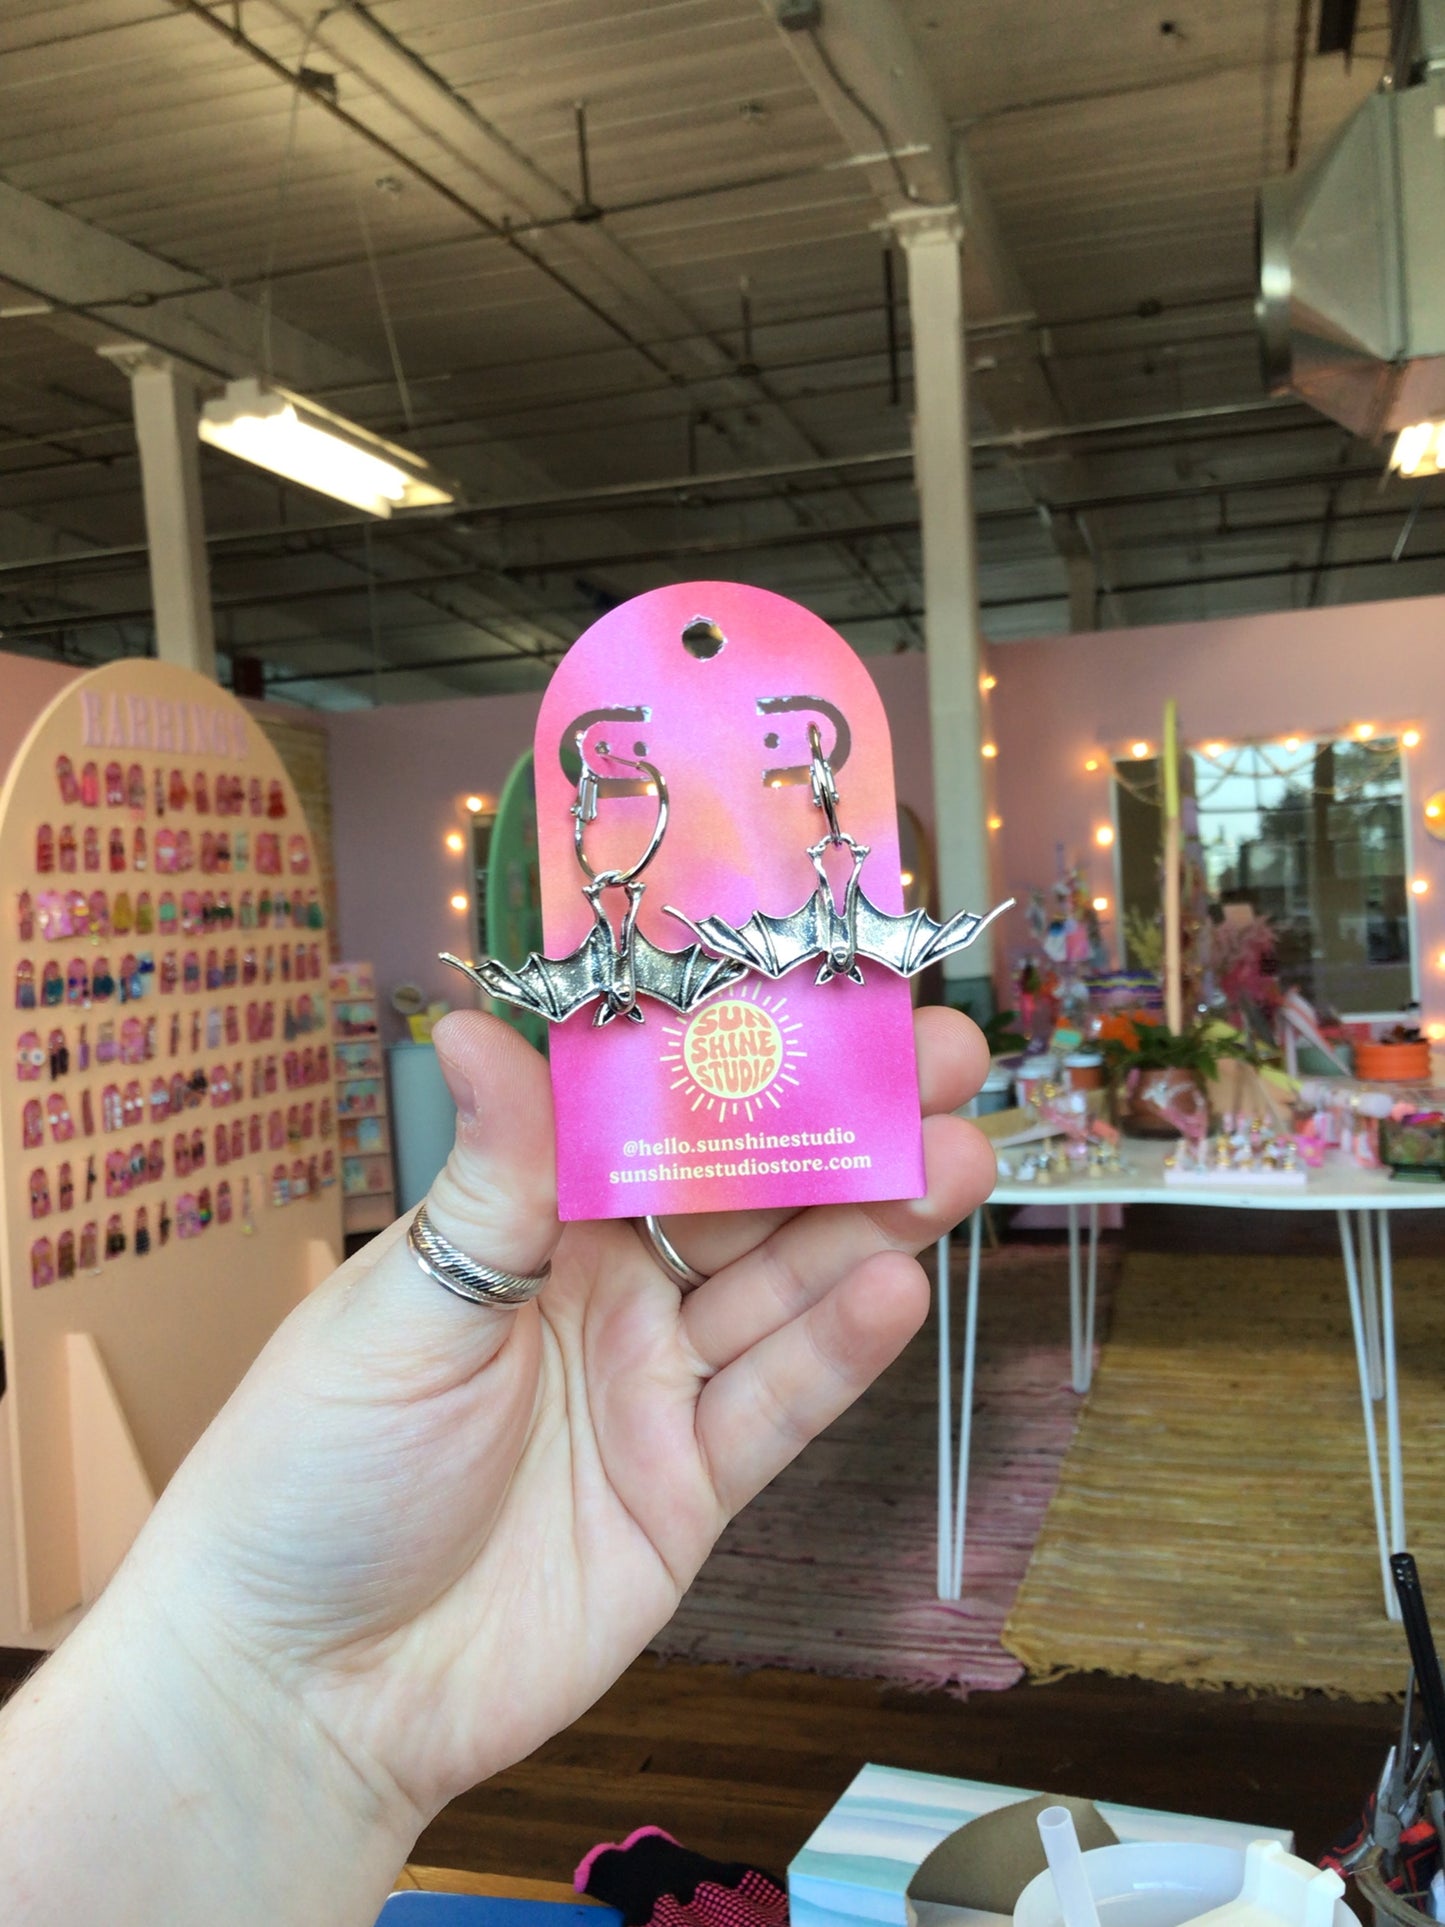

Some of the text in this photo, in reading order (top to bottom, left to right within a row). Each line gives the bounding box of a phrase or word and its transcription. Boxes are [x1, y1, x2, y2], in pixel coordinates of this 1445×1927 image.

[693, 1005, 772, 1036] SUN
[690, 1030, 777, 1064] SHINE
[696, 1058, 775, 1093] STUDIO
[622, 1127, 856, 1158] @hello.sunshinestudio
[609, 1153, 872, 1184] sunshinestudiostore.com
